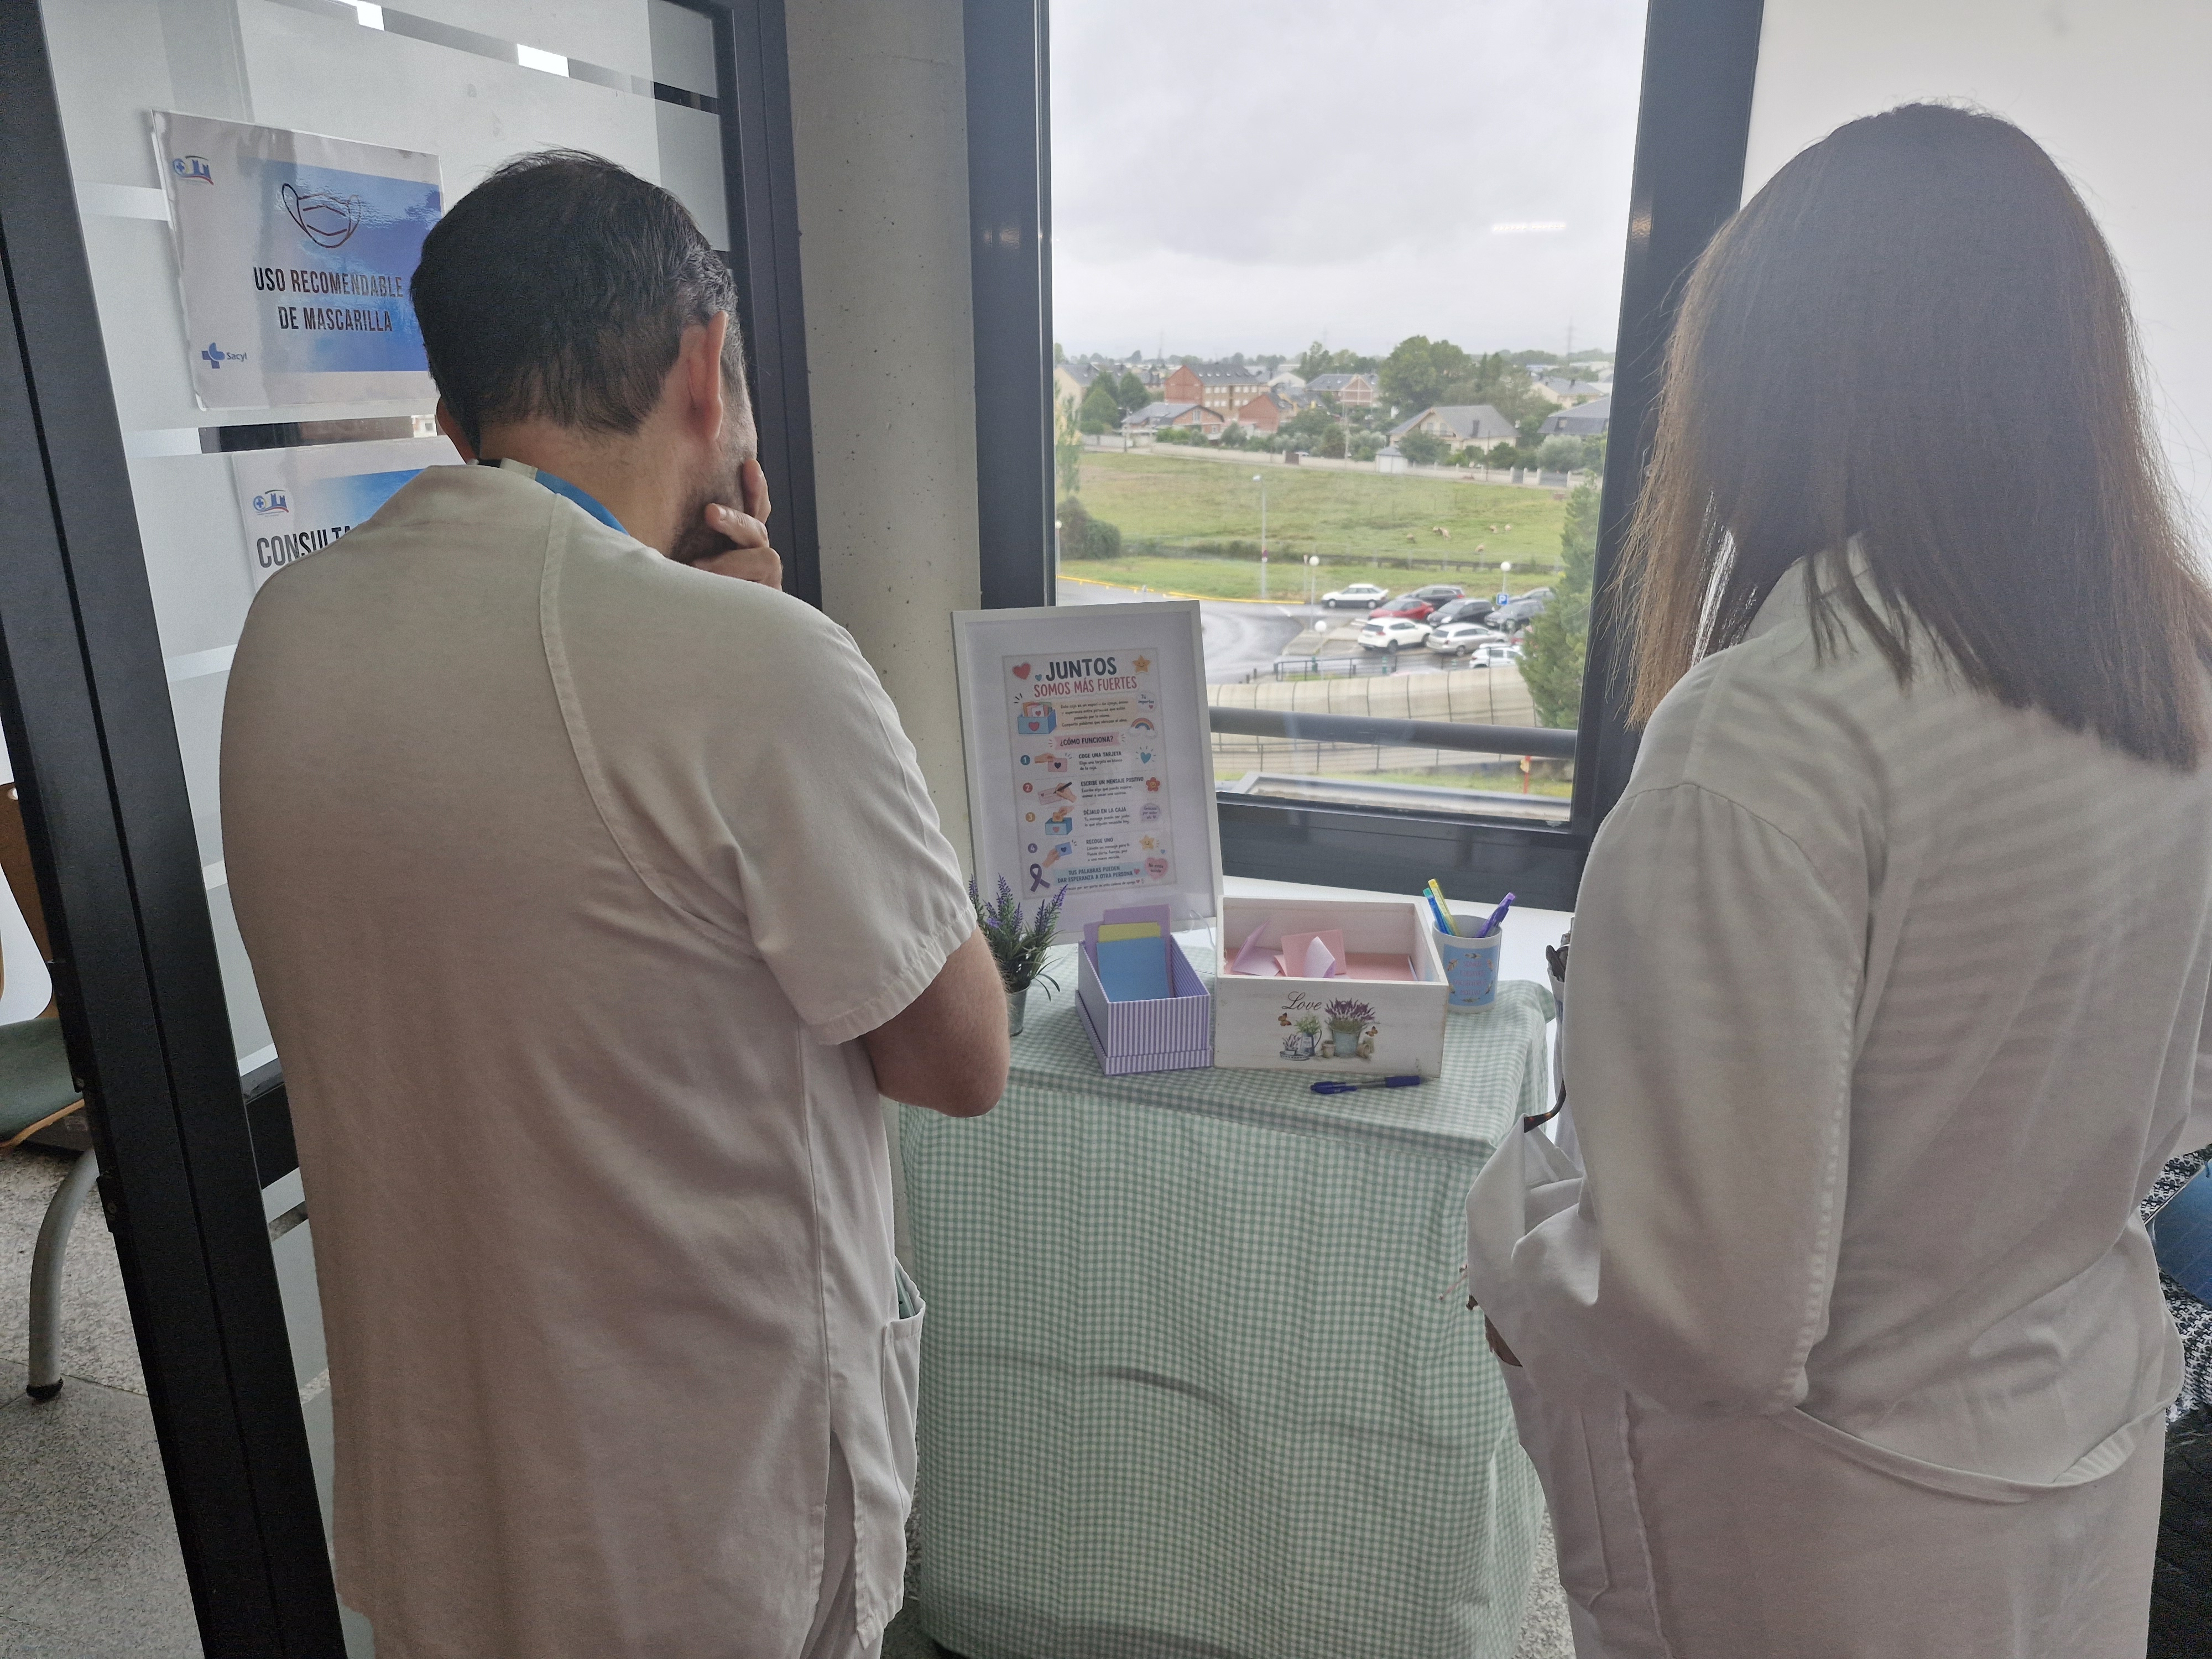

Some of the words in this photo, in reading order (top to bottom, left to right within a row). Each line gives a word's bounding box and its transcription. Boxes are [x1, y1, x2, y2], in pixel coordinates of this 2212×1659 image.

[253, 267, 285, 291] USO
[290, 269, 404, 298] RECOMENDABLE
[278, 306, 299, 330] DE
[304, 307, 393, 331] MASCARILLA
[227, 352, 247, 362] Sacyl
[257, 525, 350, 568] CONSULT
[1046, 656, 1117, 681] JUNTOS
[1034, 681, 1071, 698] SOMOS
[1074, 677, 1094, 693] MÁS
[1097, 676, 1138, 691] FUERTES
[1060, 737, 1080, 747] ¿CÓMO
[1082, 735, 1113, 744] FUNCIONA?
[1281, 991, 1322, 1010] Love
